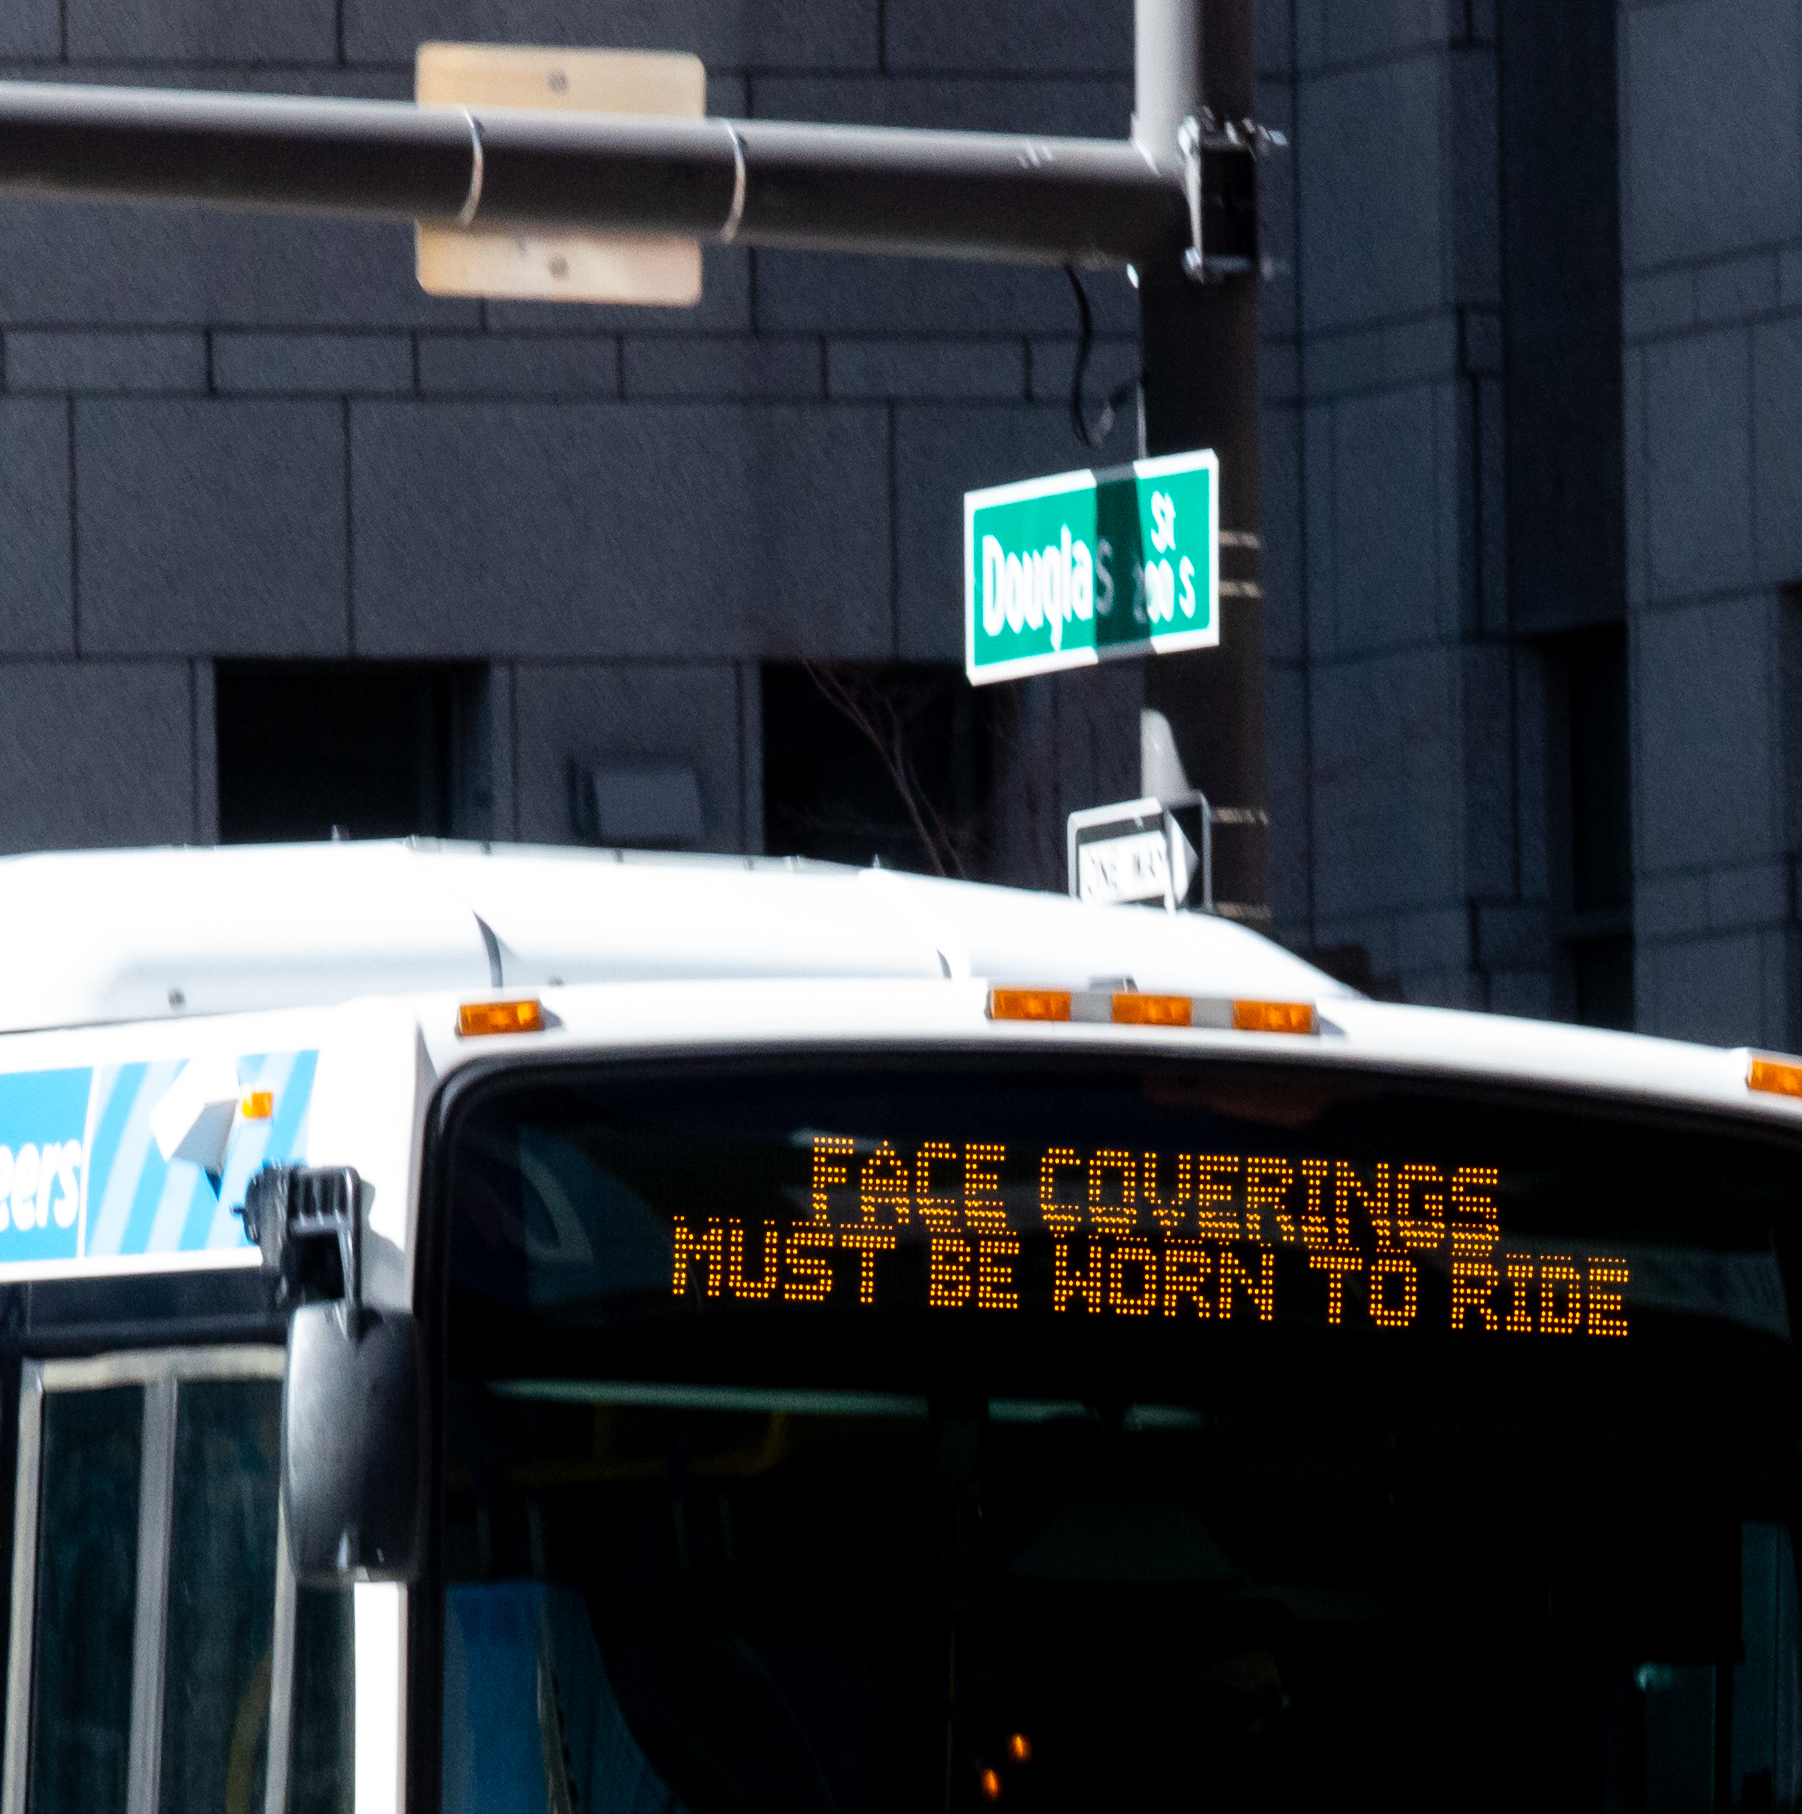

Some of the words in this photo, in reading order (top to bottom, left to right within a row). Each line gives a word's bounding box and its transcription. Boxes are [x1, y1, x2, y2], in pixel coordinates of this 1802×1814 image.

[981, 523, 1113, 652] Douglas
[1150, 489, 1177, 554] St
[1178, 554, 1196, 619] S
[811, 1136, 1007, 1229] FACE
[1040, 1147, 1500, 1252] COVERINGS
[671, 1216, 896, 1303] MUST
[927, 1228, 1021, 1310] BE
[1053, 1234, 1276, 1321] WORN
[1308, 1246, 1418, 1328] TO
[1450, 1252, 1630, 1337] RIDE
